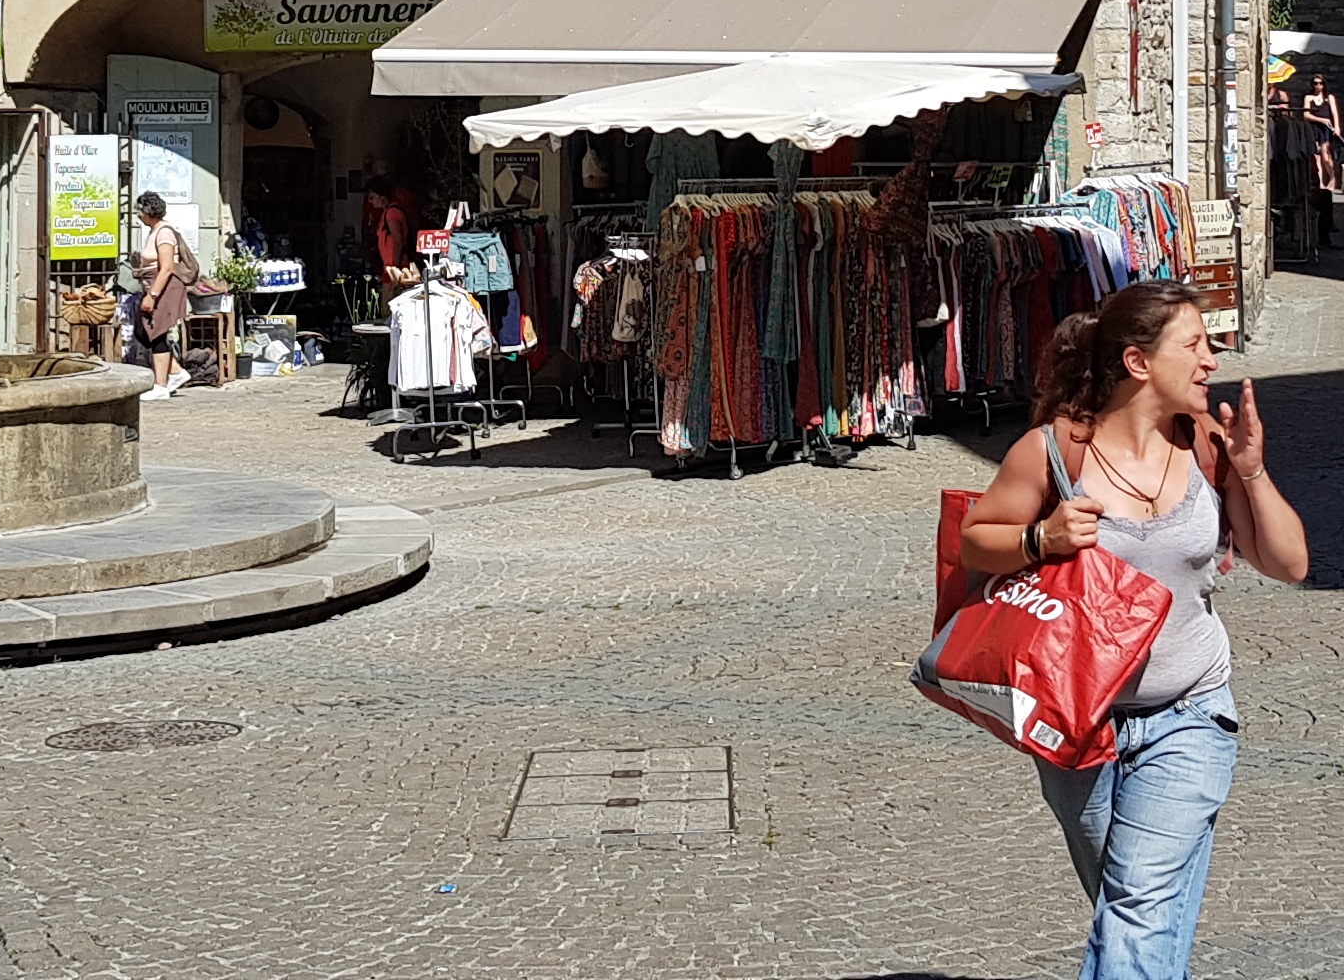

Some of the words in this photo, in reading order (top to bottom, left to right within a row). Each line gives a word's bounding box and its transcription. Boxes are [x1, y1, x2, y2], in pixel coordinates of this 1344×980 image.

[275, 30, 293, 45] de
[298, 27, 365, 45] l'Olivier
[367, 29, 388, 44] de
[128, 102, 168, 114] MOULIN
[177, 102, 208, 113] HUILE
